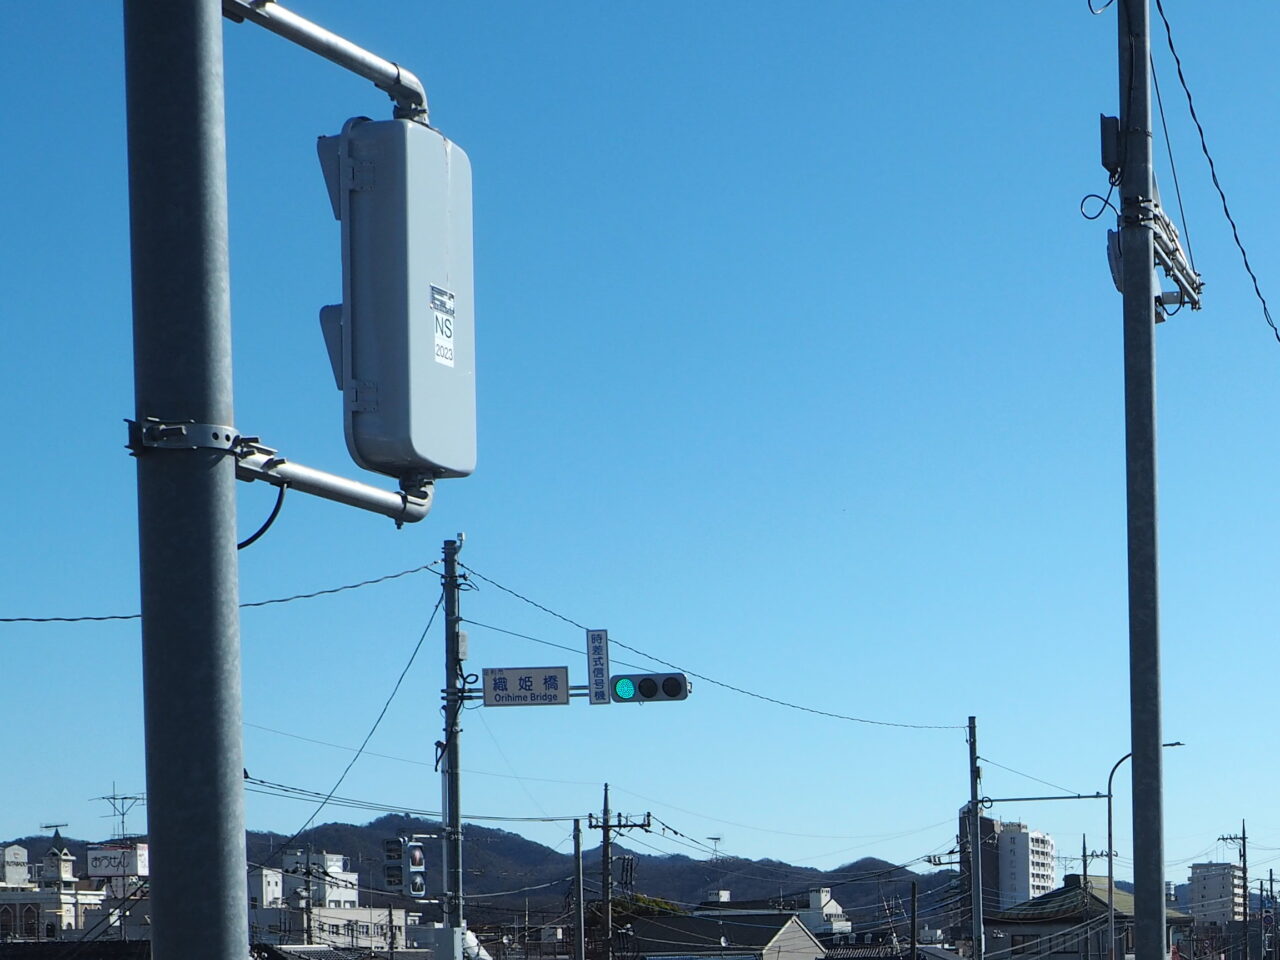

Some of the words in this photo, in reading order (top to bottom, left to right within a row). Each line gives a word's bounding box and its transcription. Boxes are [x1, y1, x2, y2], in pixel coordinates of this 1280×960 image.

[435, 314, 453, 339] NS
[435, 343, 454, 361] 2023
[591, 633, 606, 701] 時差式信号機
[493, 675, 559, 692] 織姫橋
[494, 693, 529, 703] Orihime
[530, 693, 558, 703] Bridge
